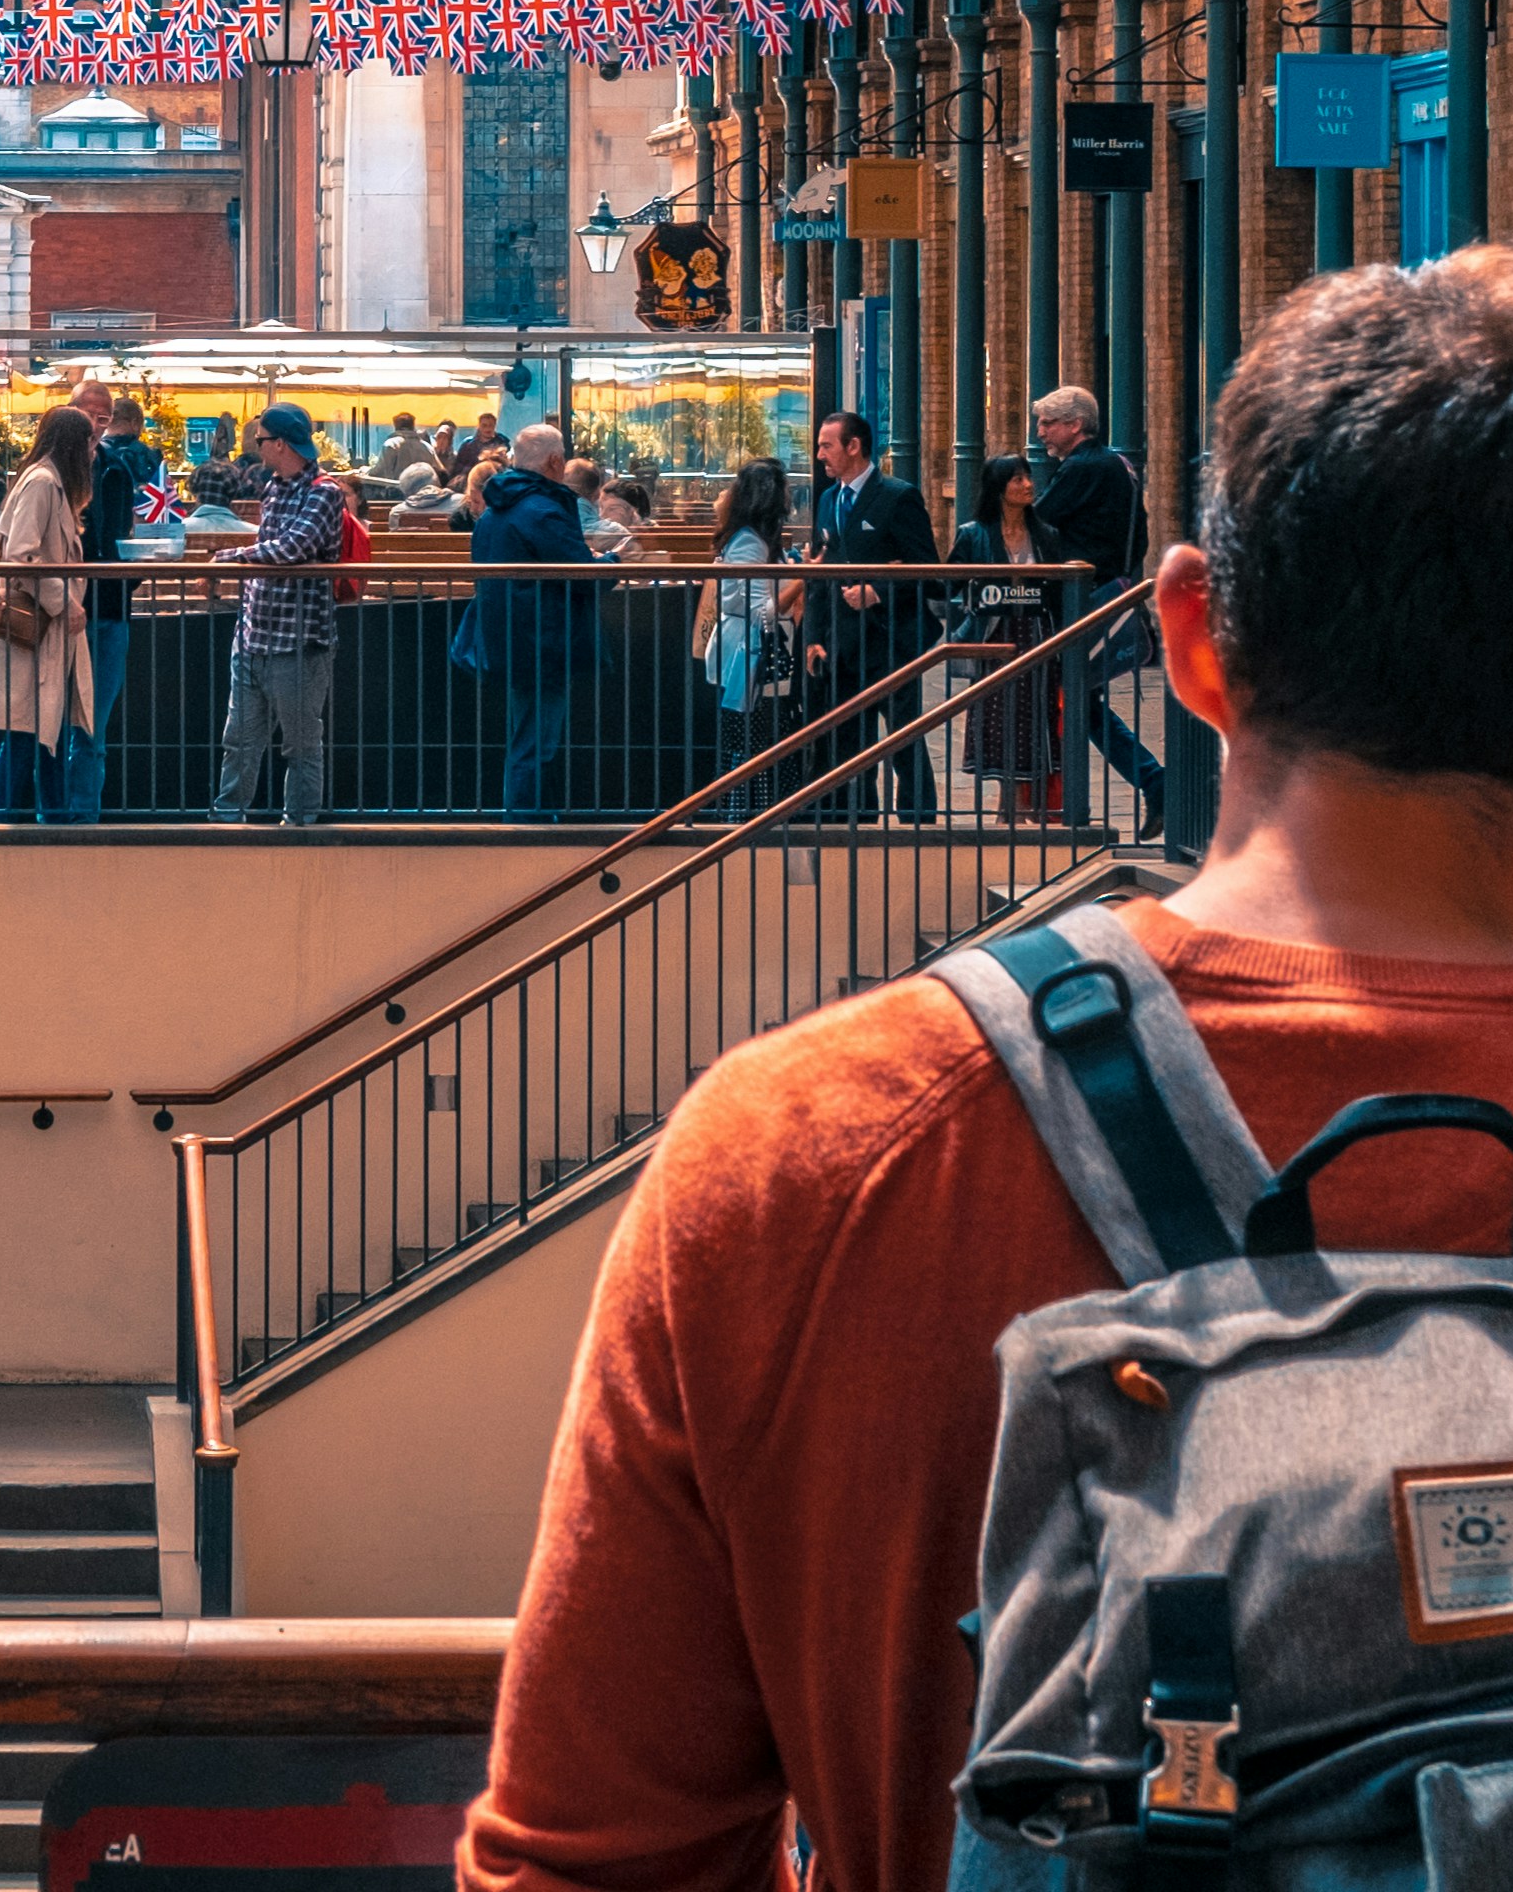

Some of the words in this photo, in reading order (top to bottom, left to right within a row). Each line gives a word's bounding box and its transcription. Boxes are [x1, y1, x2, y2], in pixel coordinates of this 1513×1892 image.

[1072, 137, 1106, 149] Miller
[1108, 138, 1145, 149] Harris
[782, 222, 841, 240] MOOMIN
[1002, 585, 1042, 597] Toilets
